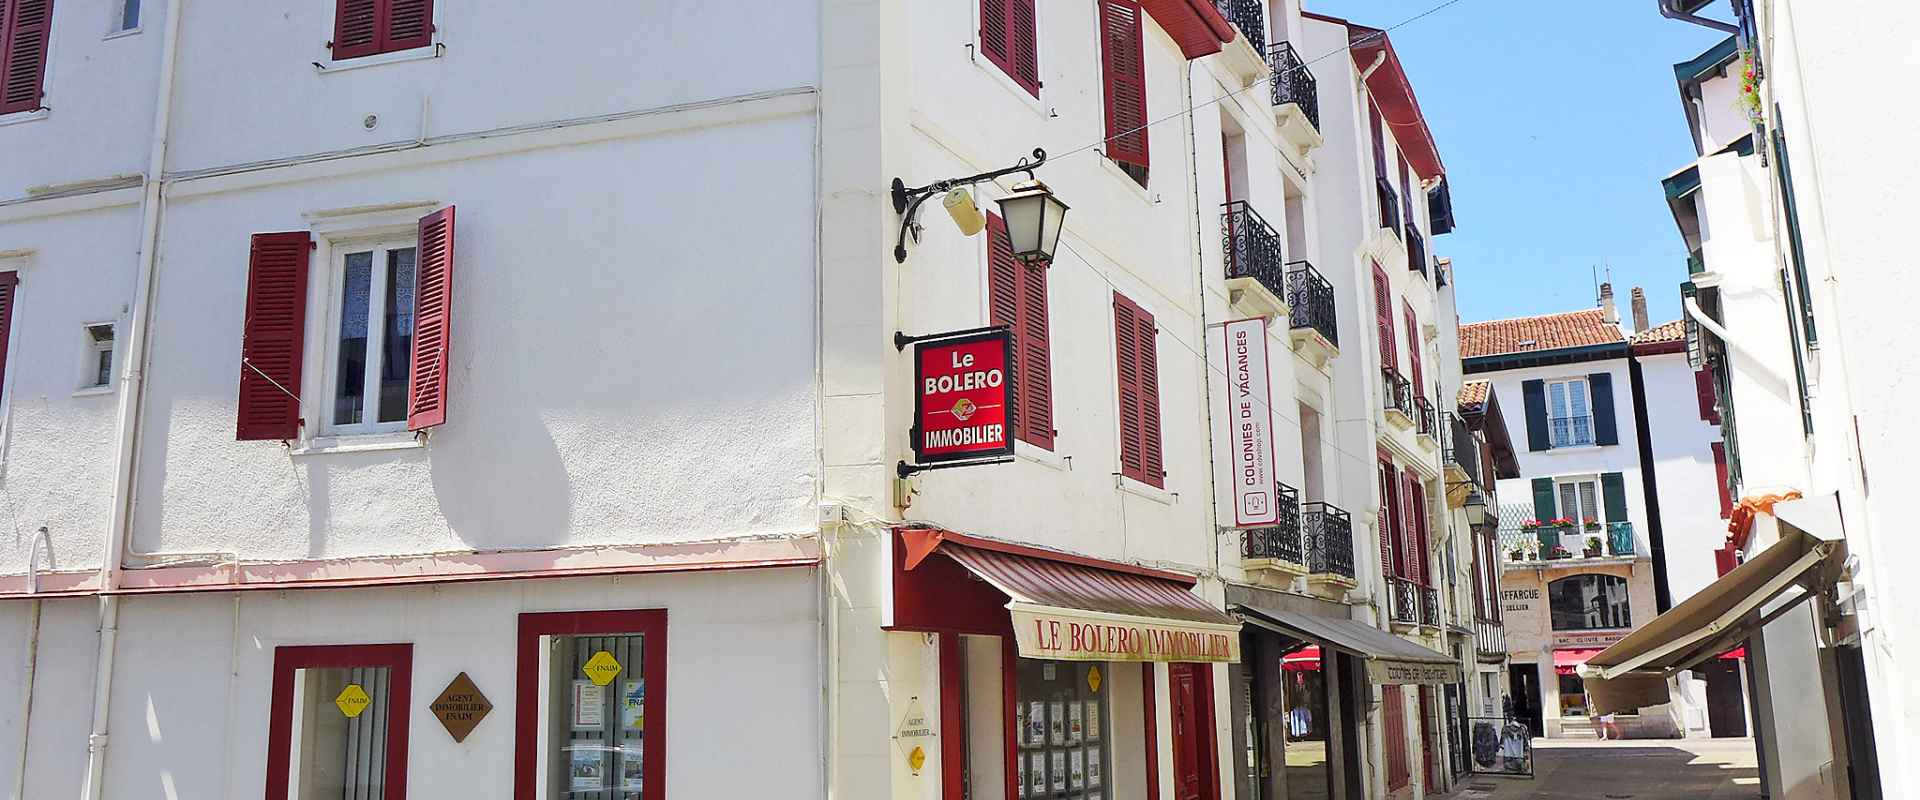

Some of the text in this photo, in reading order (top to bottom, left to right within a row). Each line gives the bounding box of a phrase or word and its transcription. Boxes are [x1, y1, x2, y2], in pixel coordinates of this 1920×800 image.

[952, 351, 974, 368] Le
[925, 369, 1003, 395] BOLERO
[1236, 330, 1255, 486] COLONIES DE VACANCES
[925, 424, 1003, 448] IMMOBILIER
[1500, 589, 1540, 600] AFFARGUE
[1035, 619, 1231, 657] LE BOLERO IMMOBILIER
[597, 664, 618, 672] FNAIM
[435, 703, 484, 711] IMMOBILIER
[629, 698, 643, 706] FNA
[447, 712, 473, 720] FNAIM
